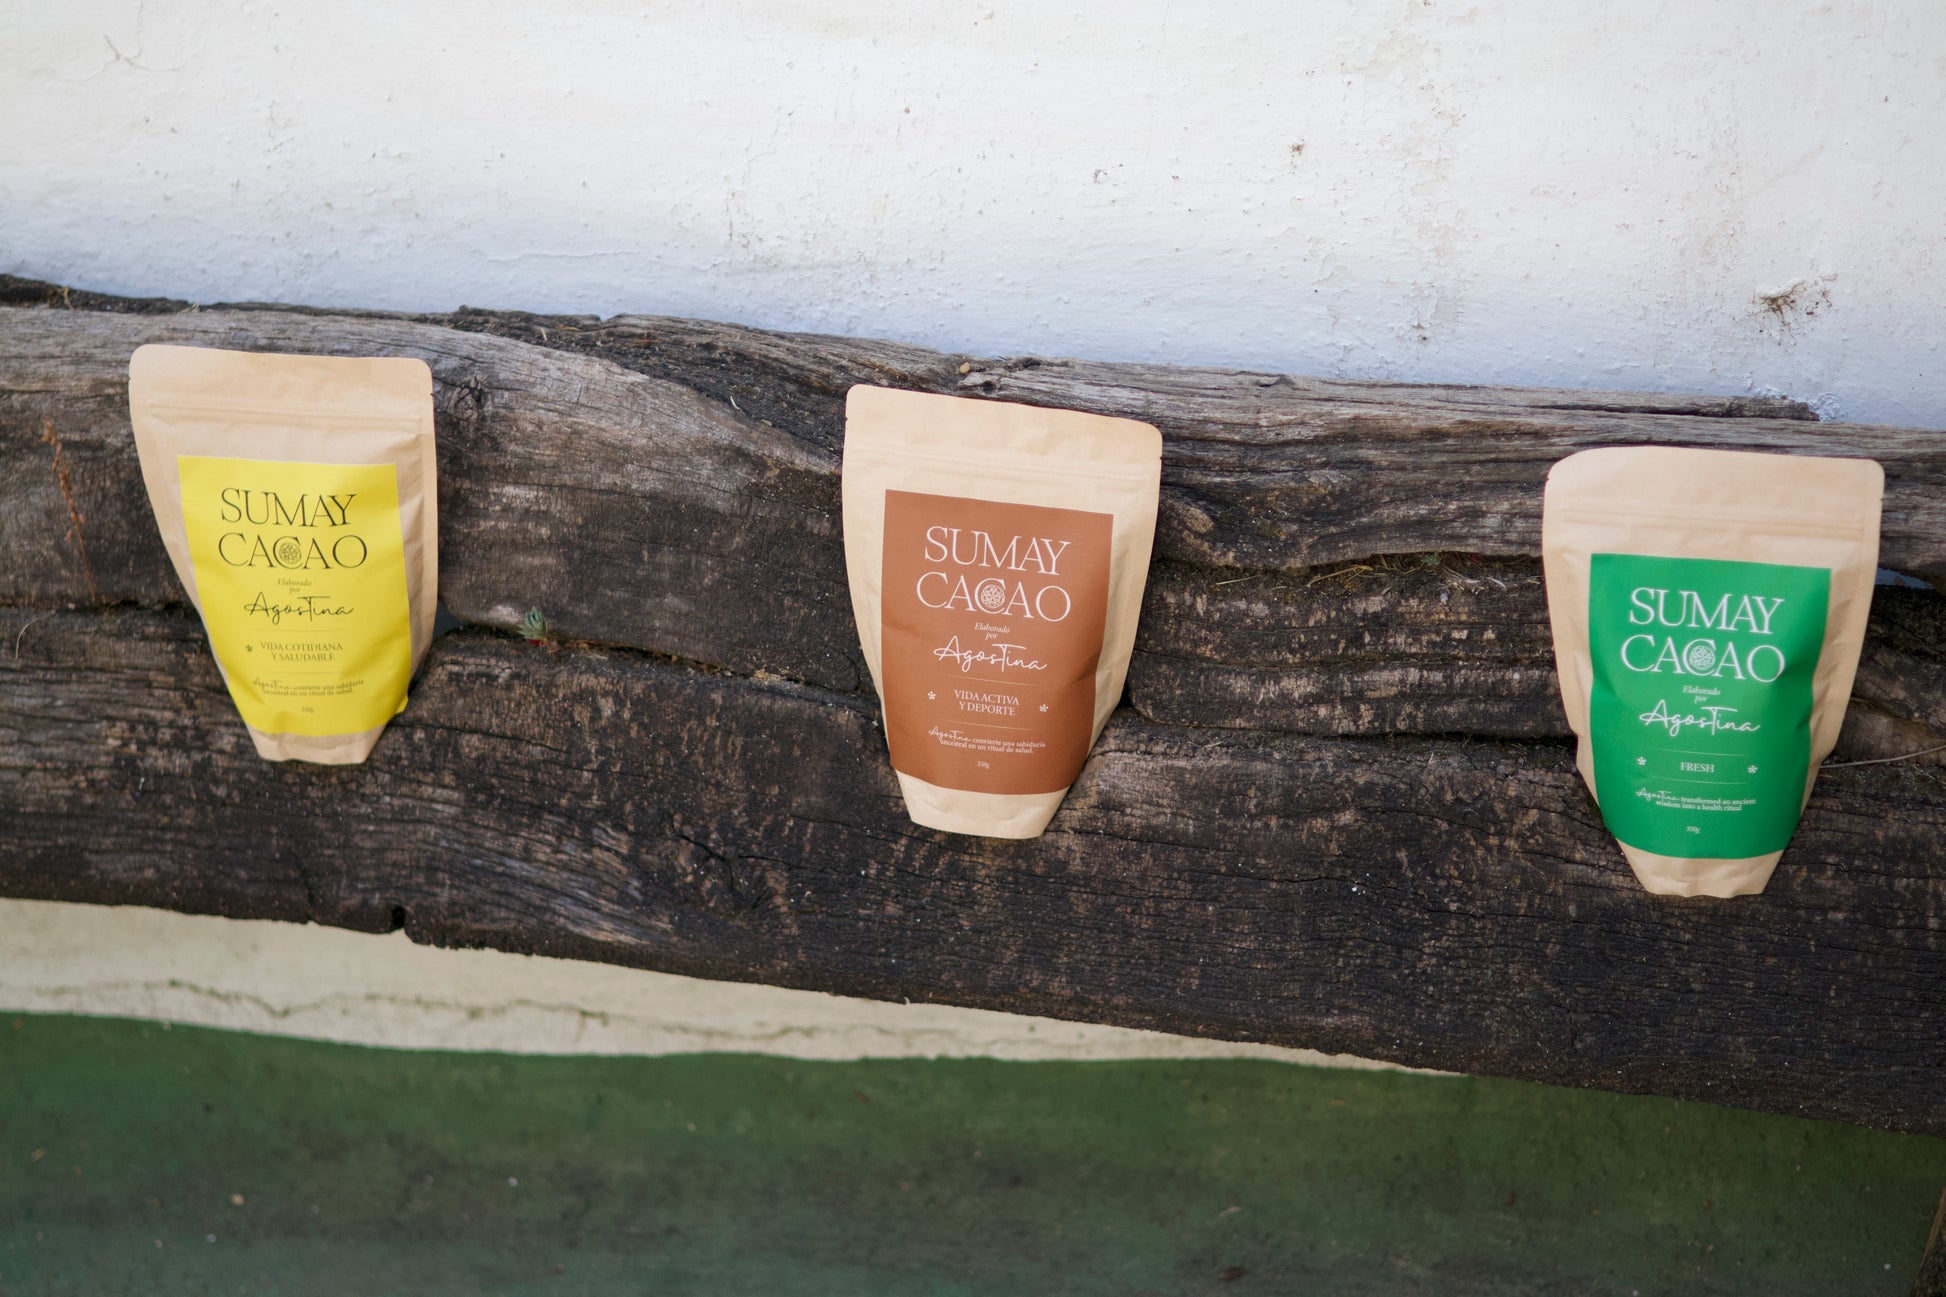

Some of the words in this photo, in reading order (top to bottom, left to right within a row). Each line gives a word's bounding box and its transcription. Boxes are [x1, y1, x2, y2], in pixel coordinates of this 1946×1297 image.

[221, 488, 358, 527] SUMAY
[218, 532, 368, 569] CACAO
[924, 526, 1071, 576] SUMAY
[278, 578, 312, 586] Elaborado
[916, 572, 1071, 622] CACAO
[1630, 587, 1785, 634] SUMAY
[974, 622, 1010, 634] Elaborado
[260, 641, 284, 651] VIDA
[285, 642, 343, 652] COTIDIANA
[272, 652, 278, 660] Y
[279, 652, 335, 662] SALUDABLE
[1620, 634, 1786, 683] CACAO
[954, 689, 980, 701] VIDA
[981, 694, 1019, 705] ACTIVA
[1682, 685, 1720, 696] Elaborado
[959, 701, 966, 710] Y
[967, 702, 1016, 716] DEPORTE
[1680, 762, 1715, 773] FRESH
[1655, 800, 1680, 808] wisdom
